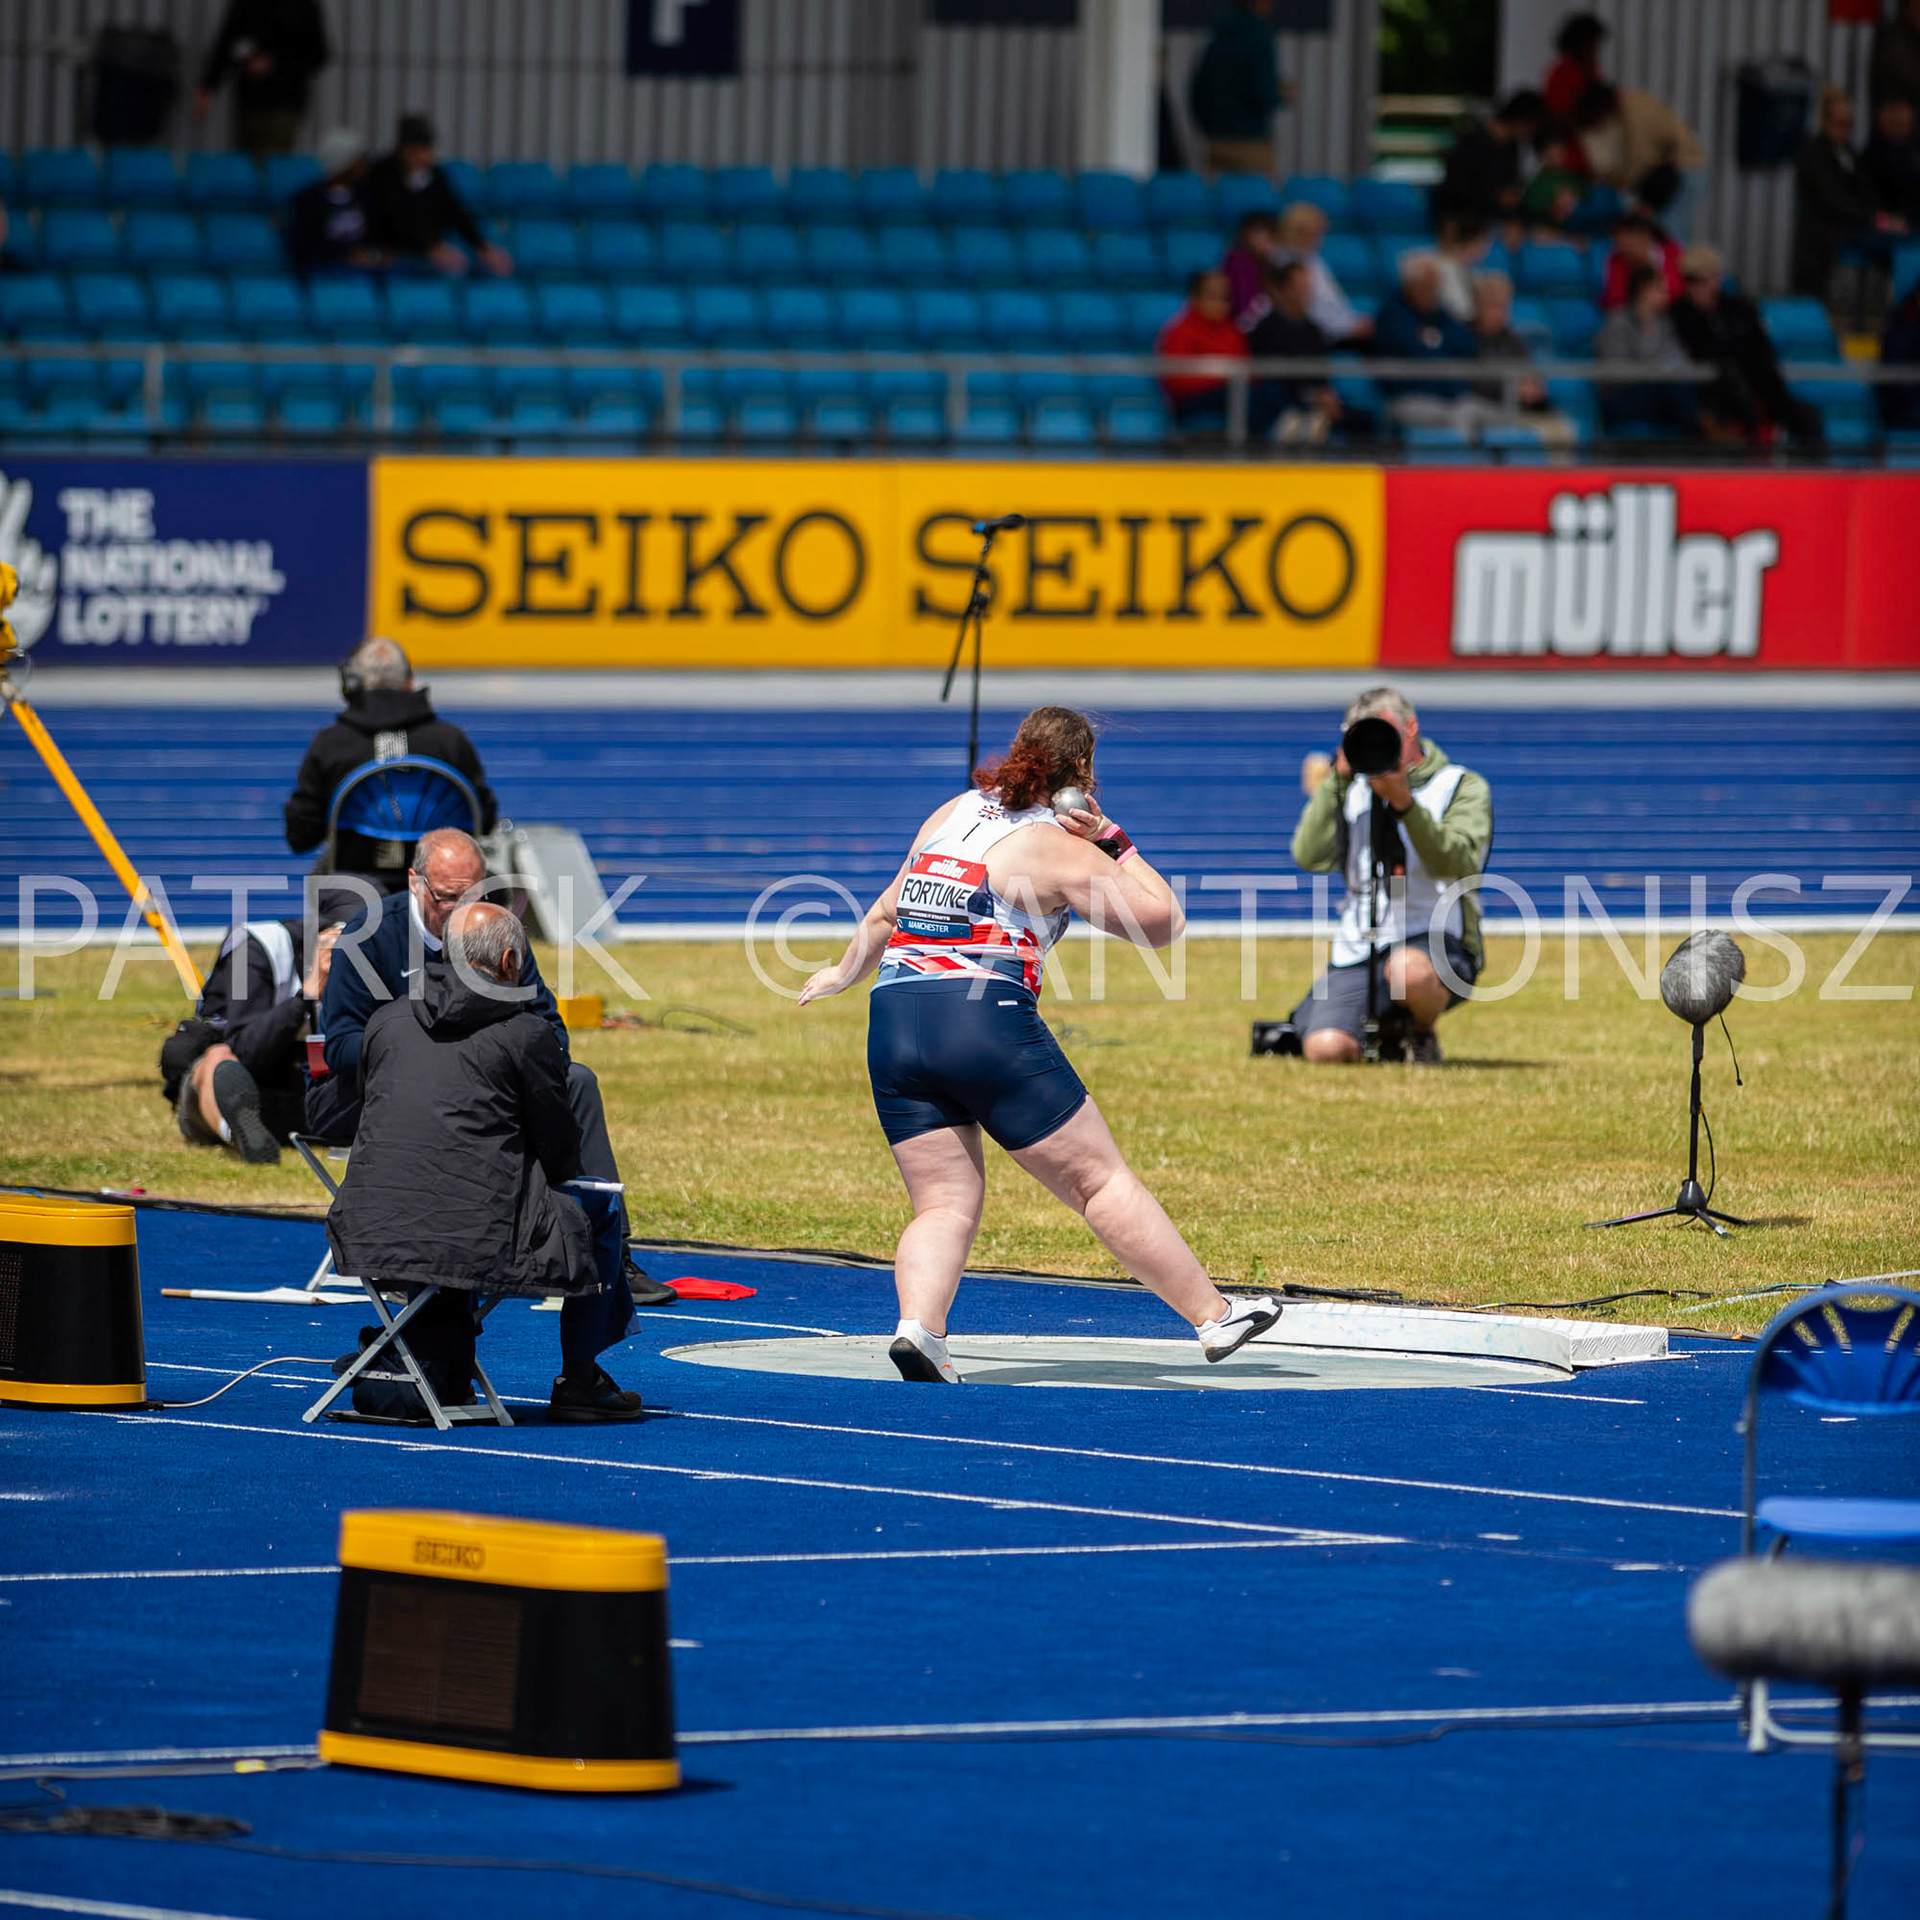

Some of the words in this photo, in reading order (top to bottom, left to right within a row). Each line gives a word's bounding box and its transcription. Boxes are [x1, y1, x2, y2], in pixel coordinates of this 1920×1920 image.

[60, 489, 154, 538] THE
[61, 540, 286, 593] NATIONAL
[401, 509, 866, 620] SEIKO
[914, 512, 1356, 622] SEIKO
[1451, 482, 1780, 656] müller
[59, 597, 268, 646] LOTTERY
[927, 858, 969, 880] müller
[901, 878, 972, 910] FORTUNE
[908, 920, 950, 933] MANCHESTER
[412, 1535, 486, 1570] SEIKO
